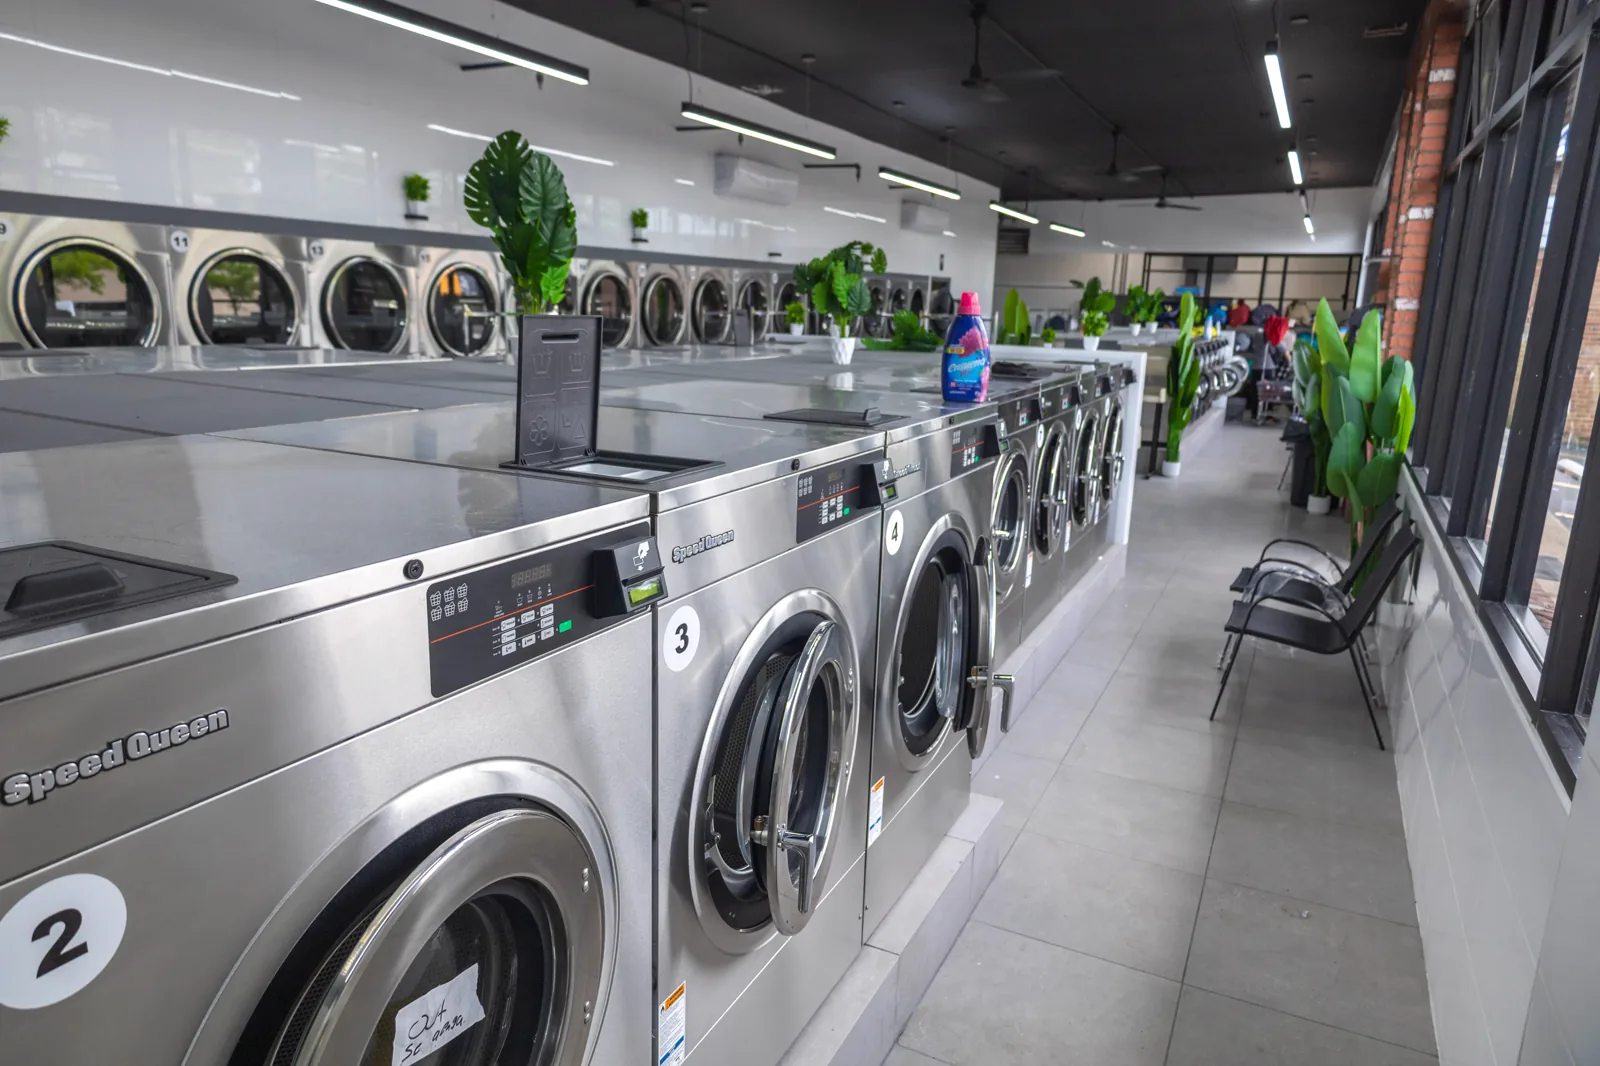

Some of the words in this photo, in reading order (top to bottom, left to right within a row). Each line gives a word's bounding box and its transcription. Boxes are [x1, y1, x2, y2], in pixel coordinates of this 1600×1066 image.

[174, 236, 188, 247] 11
[311, 245, 324, 256] 13
[672, 537, 705, 564] Speed
[705, 530, 734, 549] Queen
[891, 522, 899, 542] 4
[675, 622, 690, 654] 3
[1, 737, 126, 806] Speed
[126, 708, 229, 760] Queen
[32, 909, 89, 979] 2
